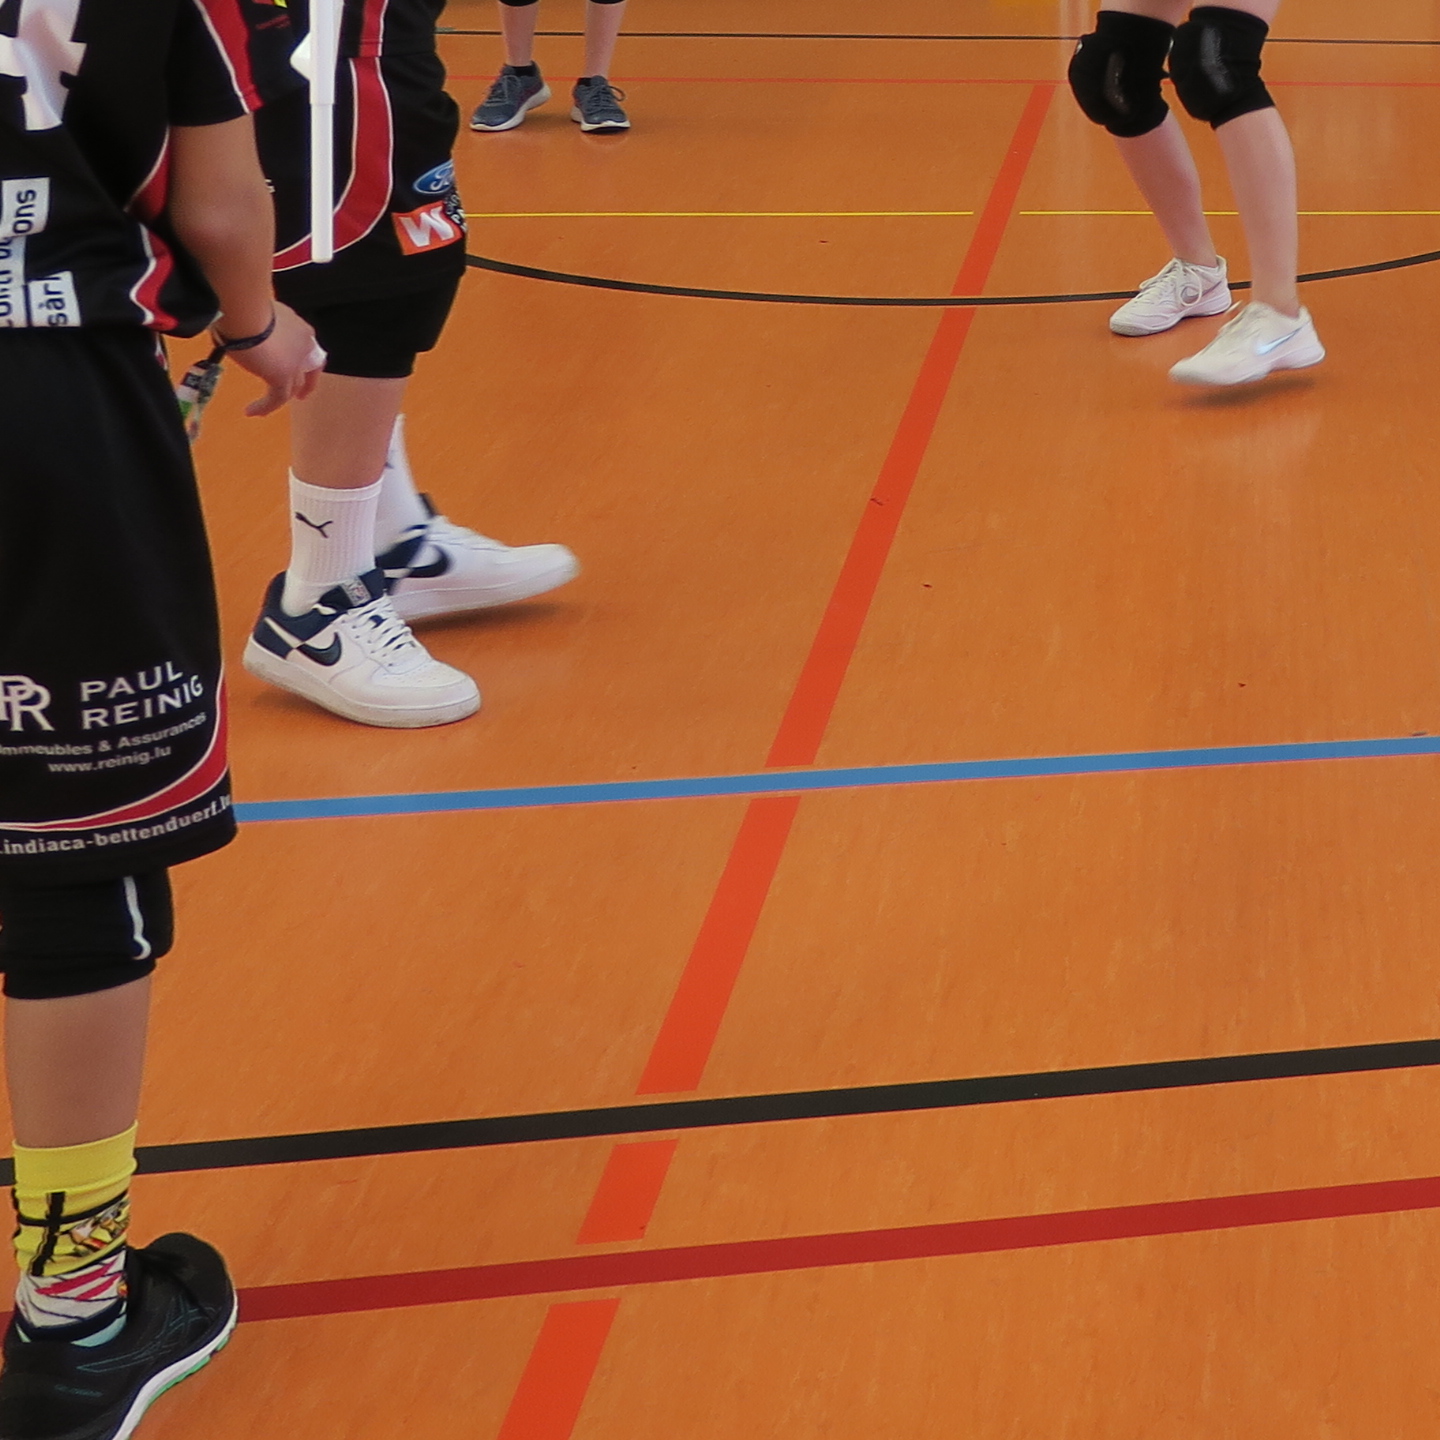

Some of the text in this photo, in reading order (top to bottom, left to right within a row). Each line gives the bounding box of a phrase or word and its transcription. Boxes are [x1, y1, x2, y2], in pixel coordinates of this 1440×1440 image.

[80, 661, 183, 702] PAUL
[82, 674, 204, 730] REINIG
[98, 740, 112, 752] &
[117, 711, 207, 749] Assurances
[48, 746, 172, 773] www.reinig.lu
